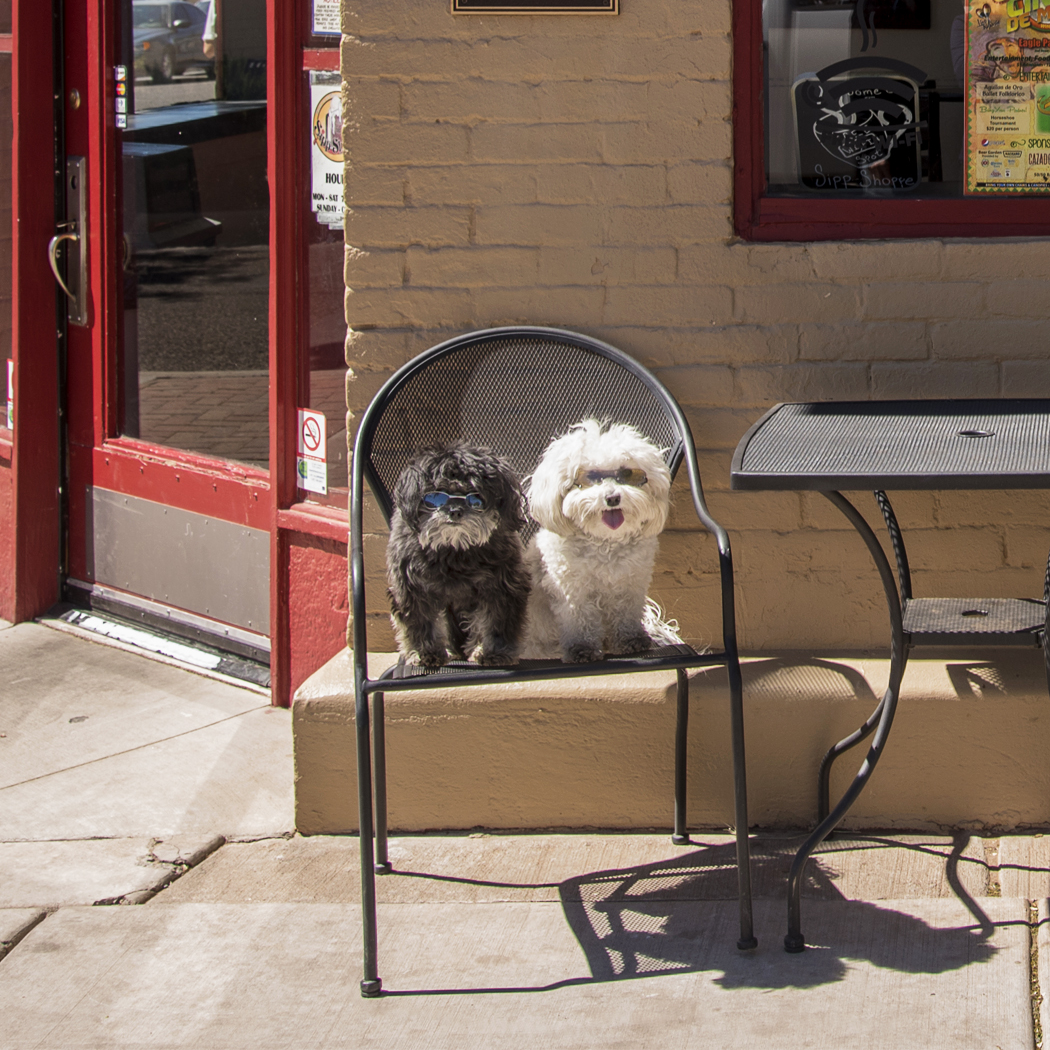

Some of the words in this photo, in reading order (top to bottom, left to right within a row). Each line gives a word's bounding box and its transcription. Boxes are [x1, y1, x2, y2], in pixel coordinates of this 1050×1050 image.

[1006, 13, 1031, 33] DE
[1018, 38, 1041, 49] Eagle
[312, 193, 325, 201] MON
[329, 194, 338, 202] SAT
[316, 204, 337, 213] SUNDAY
